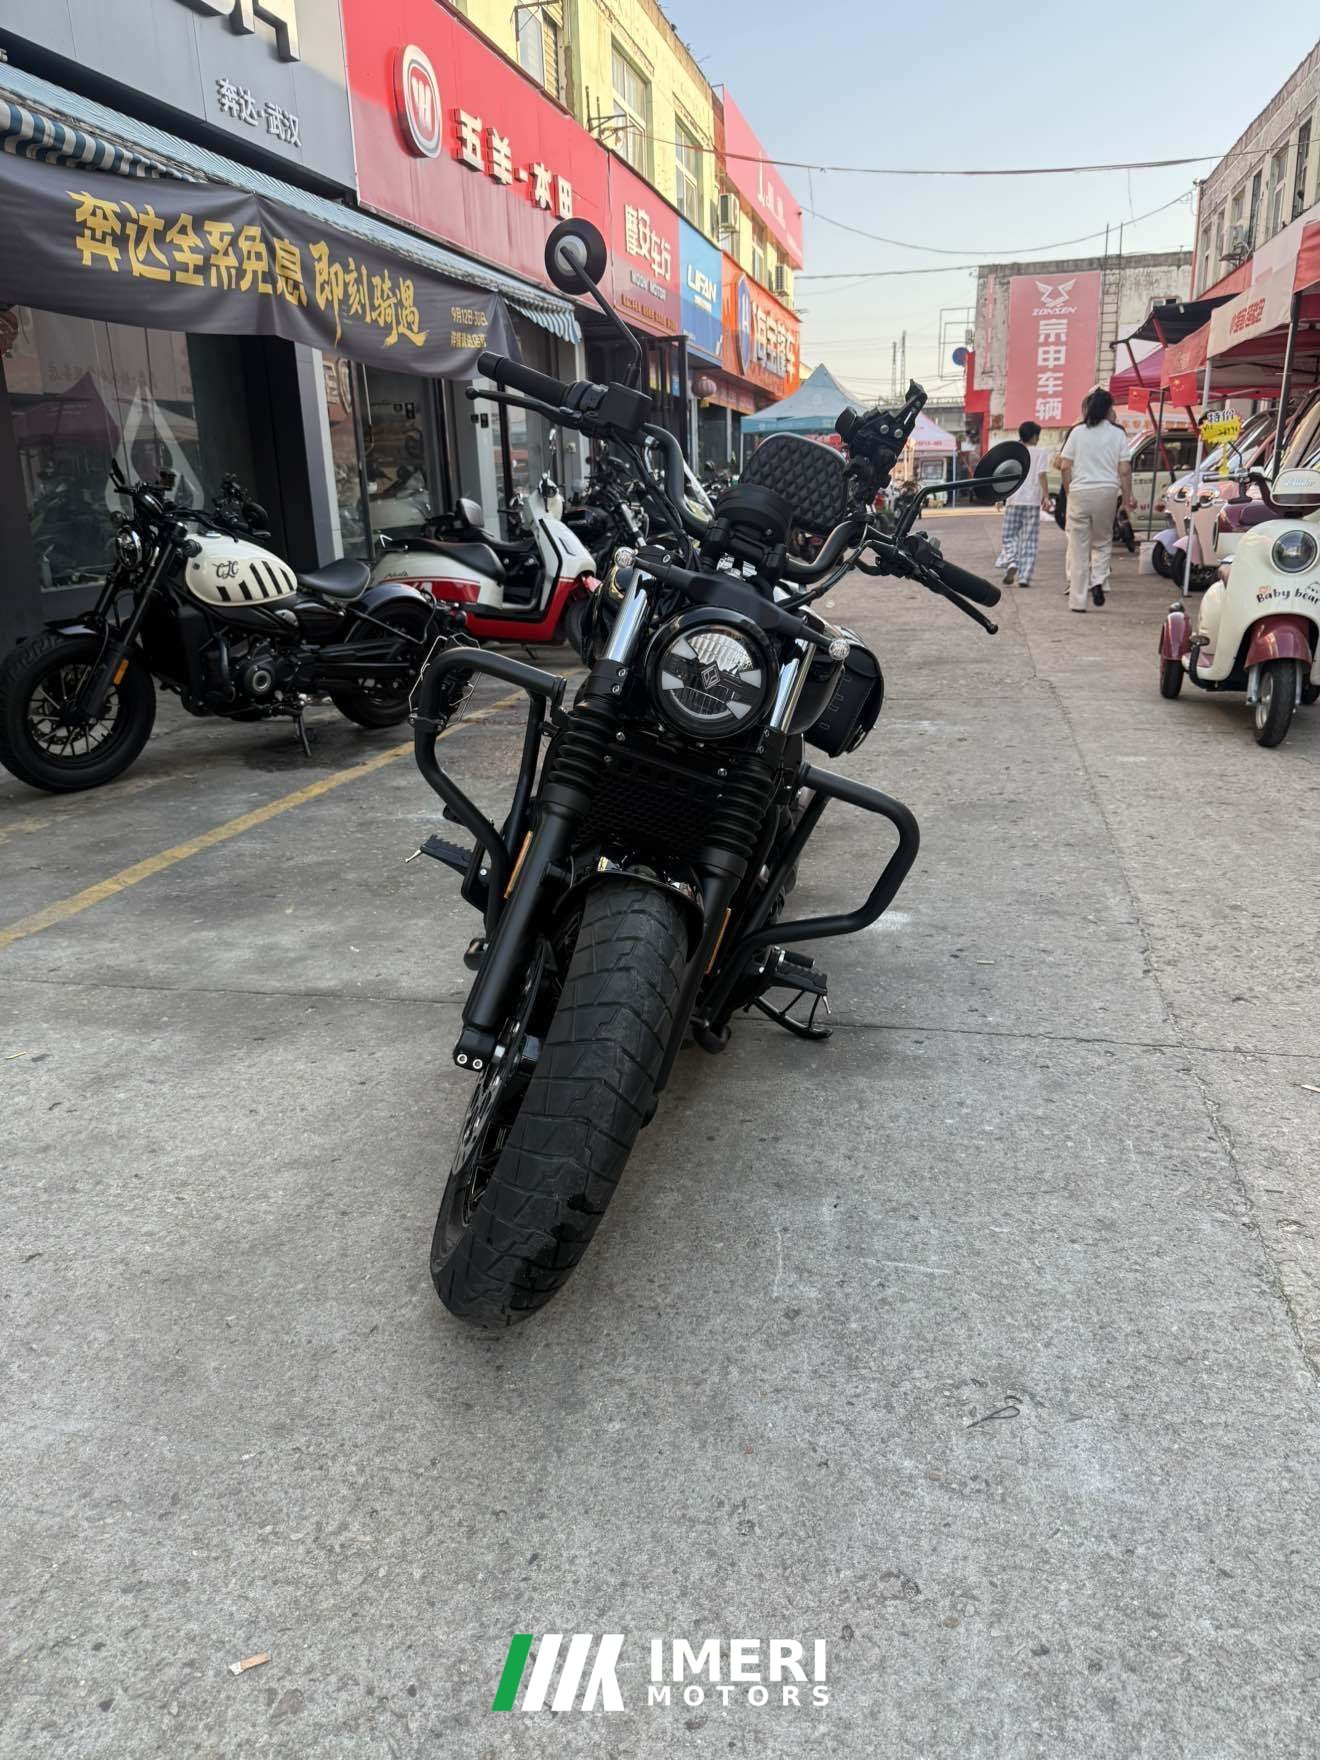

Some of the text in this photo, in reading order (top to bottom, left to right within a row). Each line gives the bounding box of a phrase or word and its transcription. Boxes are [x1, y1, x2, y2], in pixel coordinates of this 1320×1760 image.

[216, 78, 302, 148] 奔达·武汉
[66, 190, 430, 348] 奔达全系免息 即刻骑遇
[687, 264, 717, 303] LIFAN
[1035, 319, 1068, 421] 宗申车辆
[1256, 588, 1290, 603] Baby
